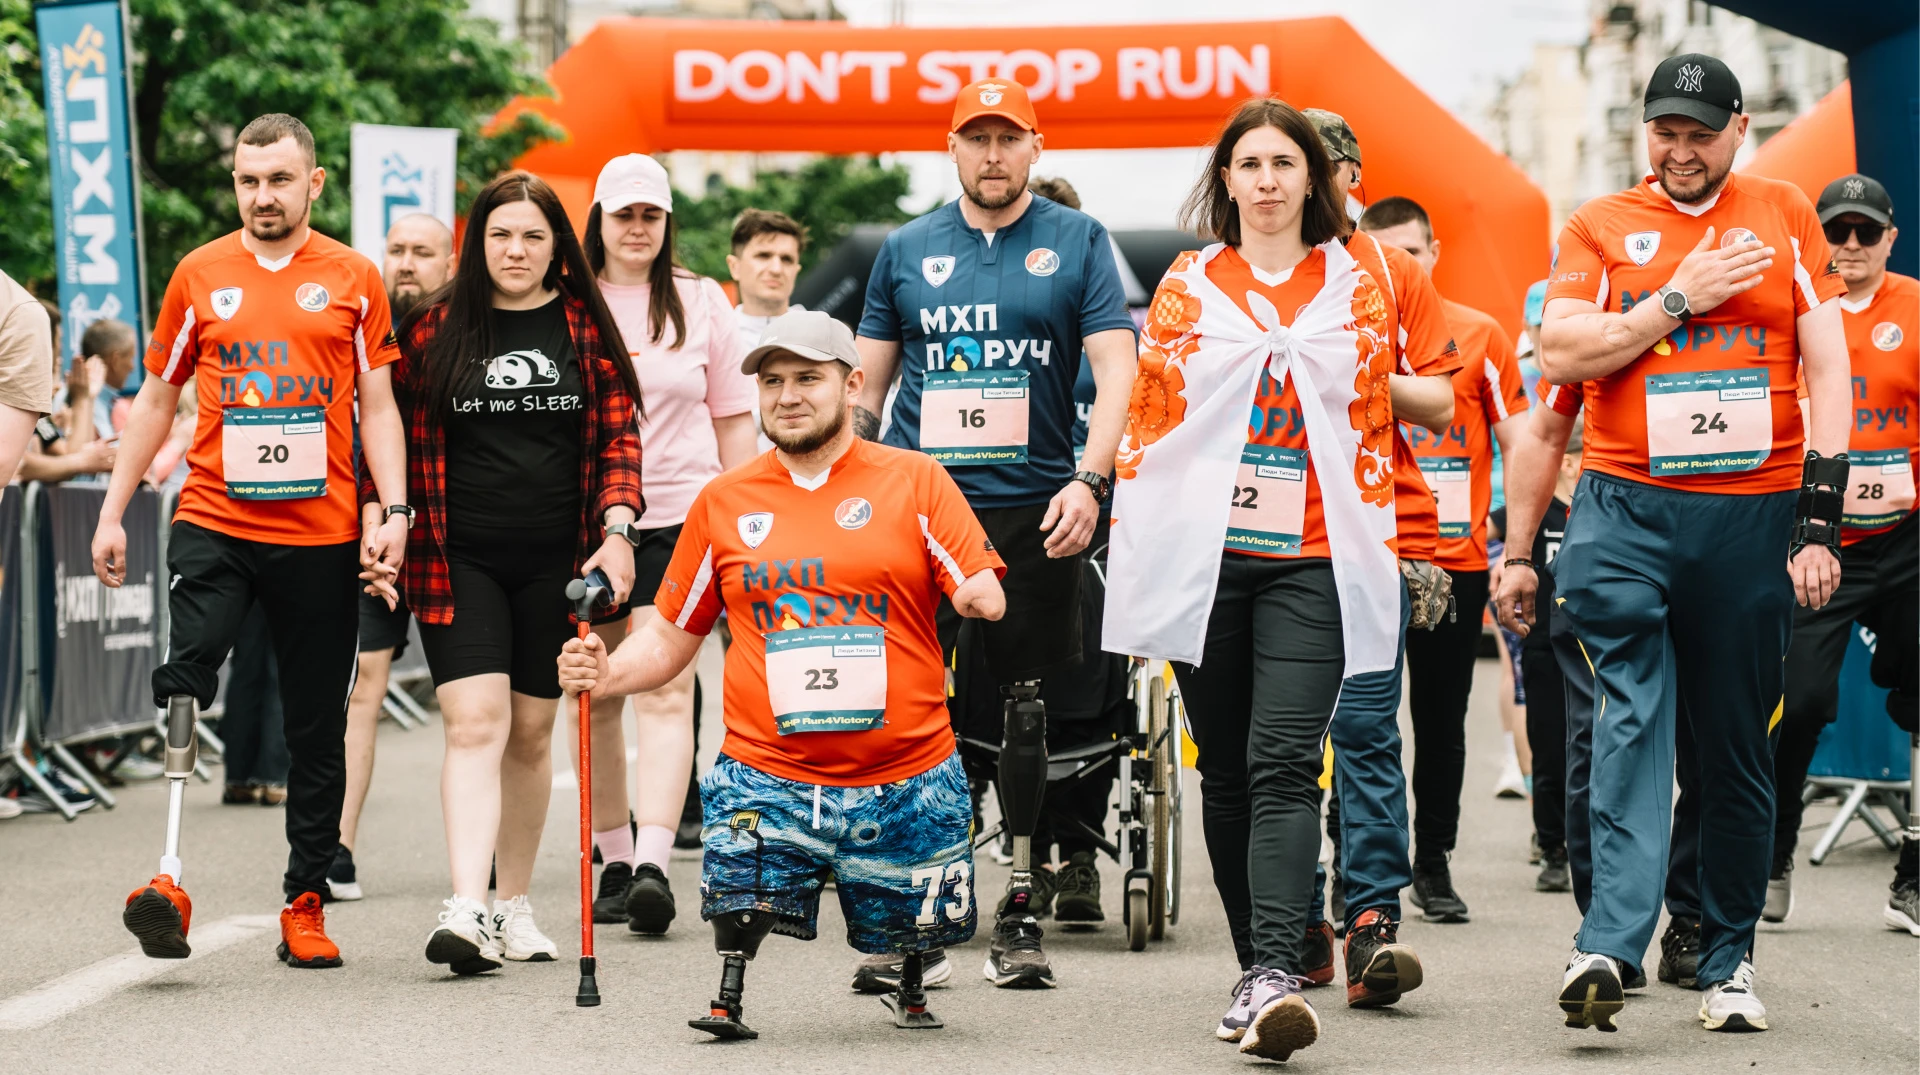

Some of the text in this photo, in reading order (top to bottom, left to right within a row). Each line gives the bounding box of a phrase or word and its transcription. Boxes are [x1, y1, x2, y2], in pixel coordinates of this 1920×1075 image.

[673, 44, 1270, 102] DON'T STOP RUN
[920, 303, 998, 335] МХП
[218, 340, 289, 370] МХП
[452, 396, 484, 413] Let
[489, 398, 517, 413] me
[958, 408, 986, 429] 16
[1690, 411, 1728, 435] 24
[257, 444, 290, 464] 20
[954, 451, 1018, 460] Run4Victory
[1661, 457, 1760, 470] MHP Run4Victory
[233, 485, 318, 494] MHP Run4Victory
[1231, 484, 1259, 510] 22
[1857, 483, 1884, 500] 28
[1224, 533, 1289, 549] un4Victory
[743, 557, 825, 593] МХП
[804, 668, 839, 691] 23
[781, 716, 874, 728] MHP Run4Victory
[911, 860, 972, 928] 73
